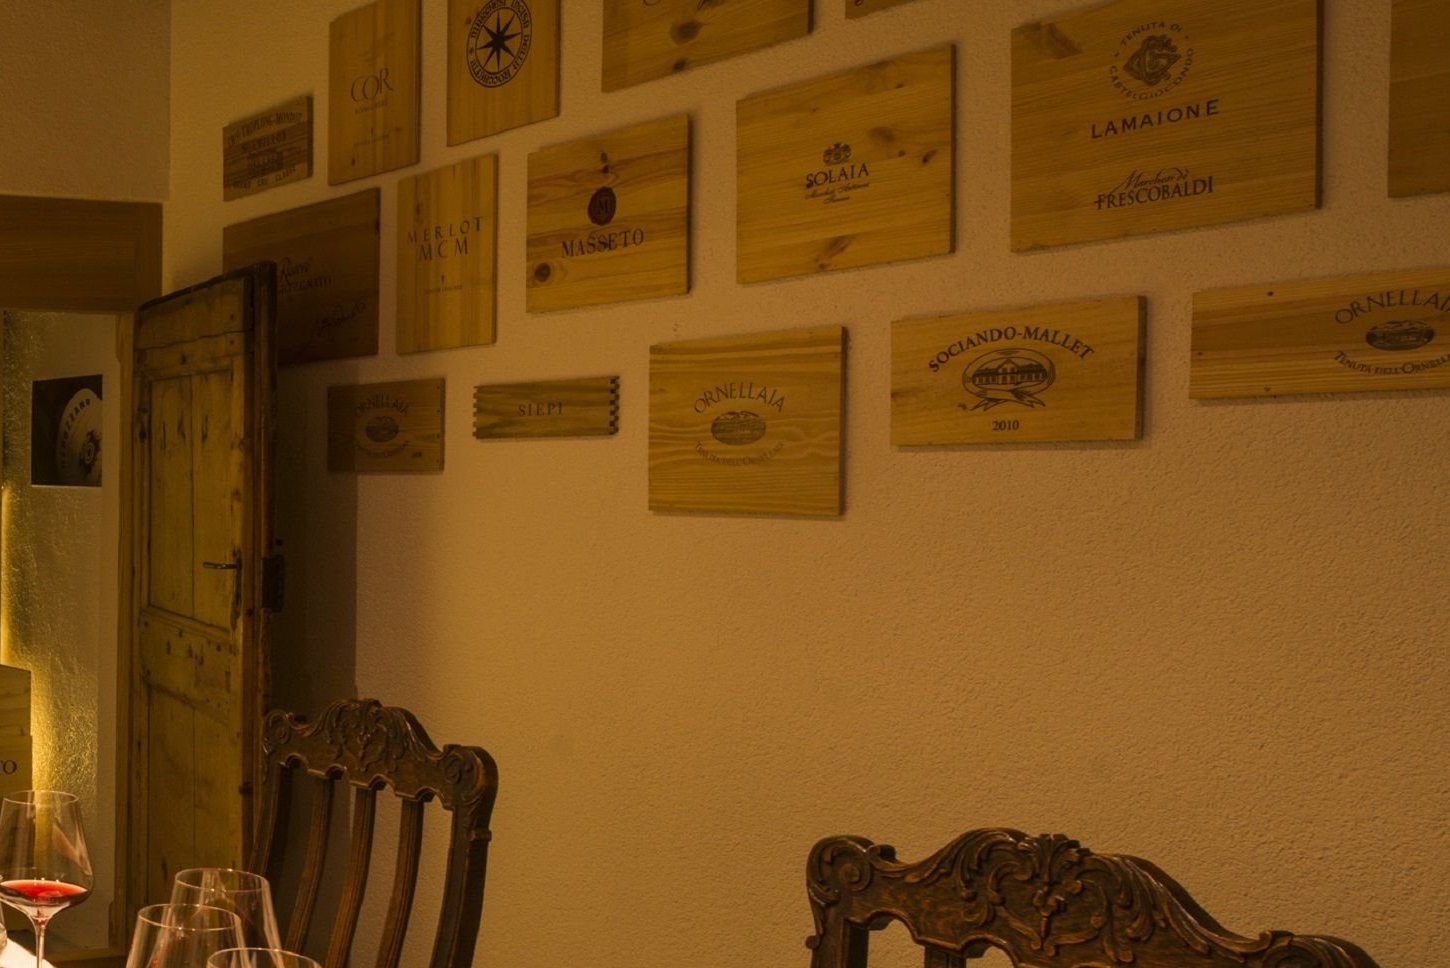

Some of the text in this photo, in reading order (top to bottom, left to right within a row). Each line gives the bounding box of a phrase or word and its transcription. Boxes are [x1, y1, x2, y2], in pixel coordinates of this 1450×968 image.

[350, 67, 394, 103] COR
[1091, 98, 1220, 139] LAMAIONE
[805, 162, 870, 189] SOLAIA
[1093, 175, 1215, 211] FRESCOBALDI
[407, 216, 483, 246] MERLOT
[560, 228, 645, 259] MASSETO
[418, 236, 469, 263] MCM
[928, 325, 1095, 373] SOCIANDO-MALLET
[517, 400, 564, 417] SIEPI
[694, 381, 785, 413] ORNELLAIA
[991, 418, 1020, 432] 2010
